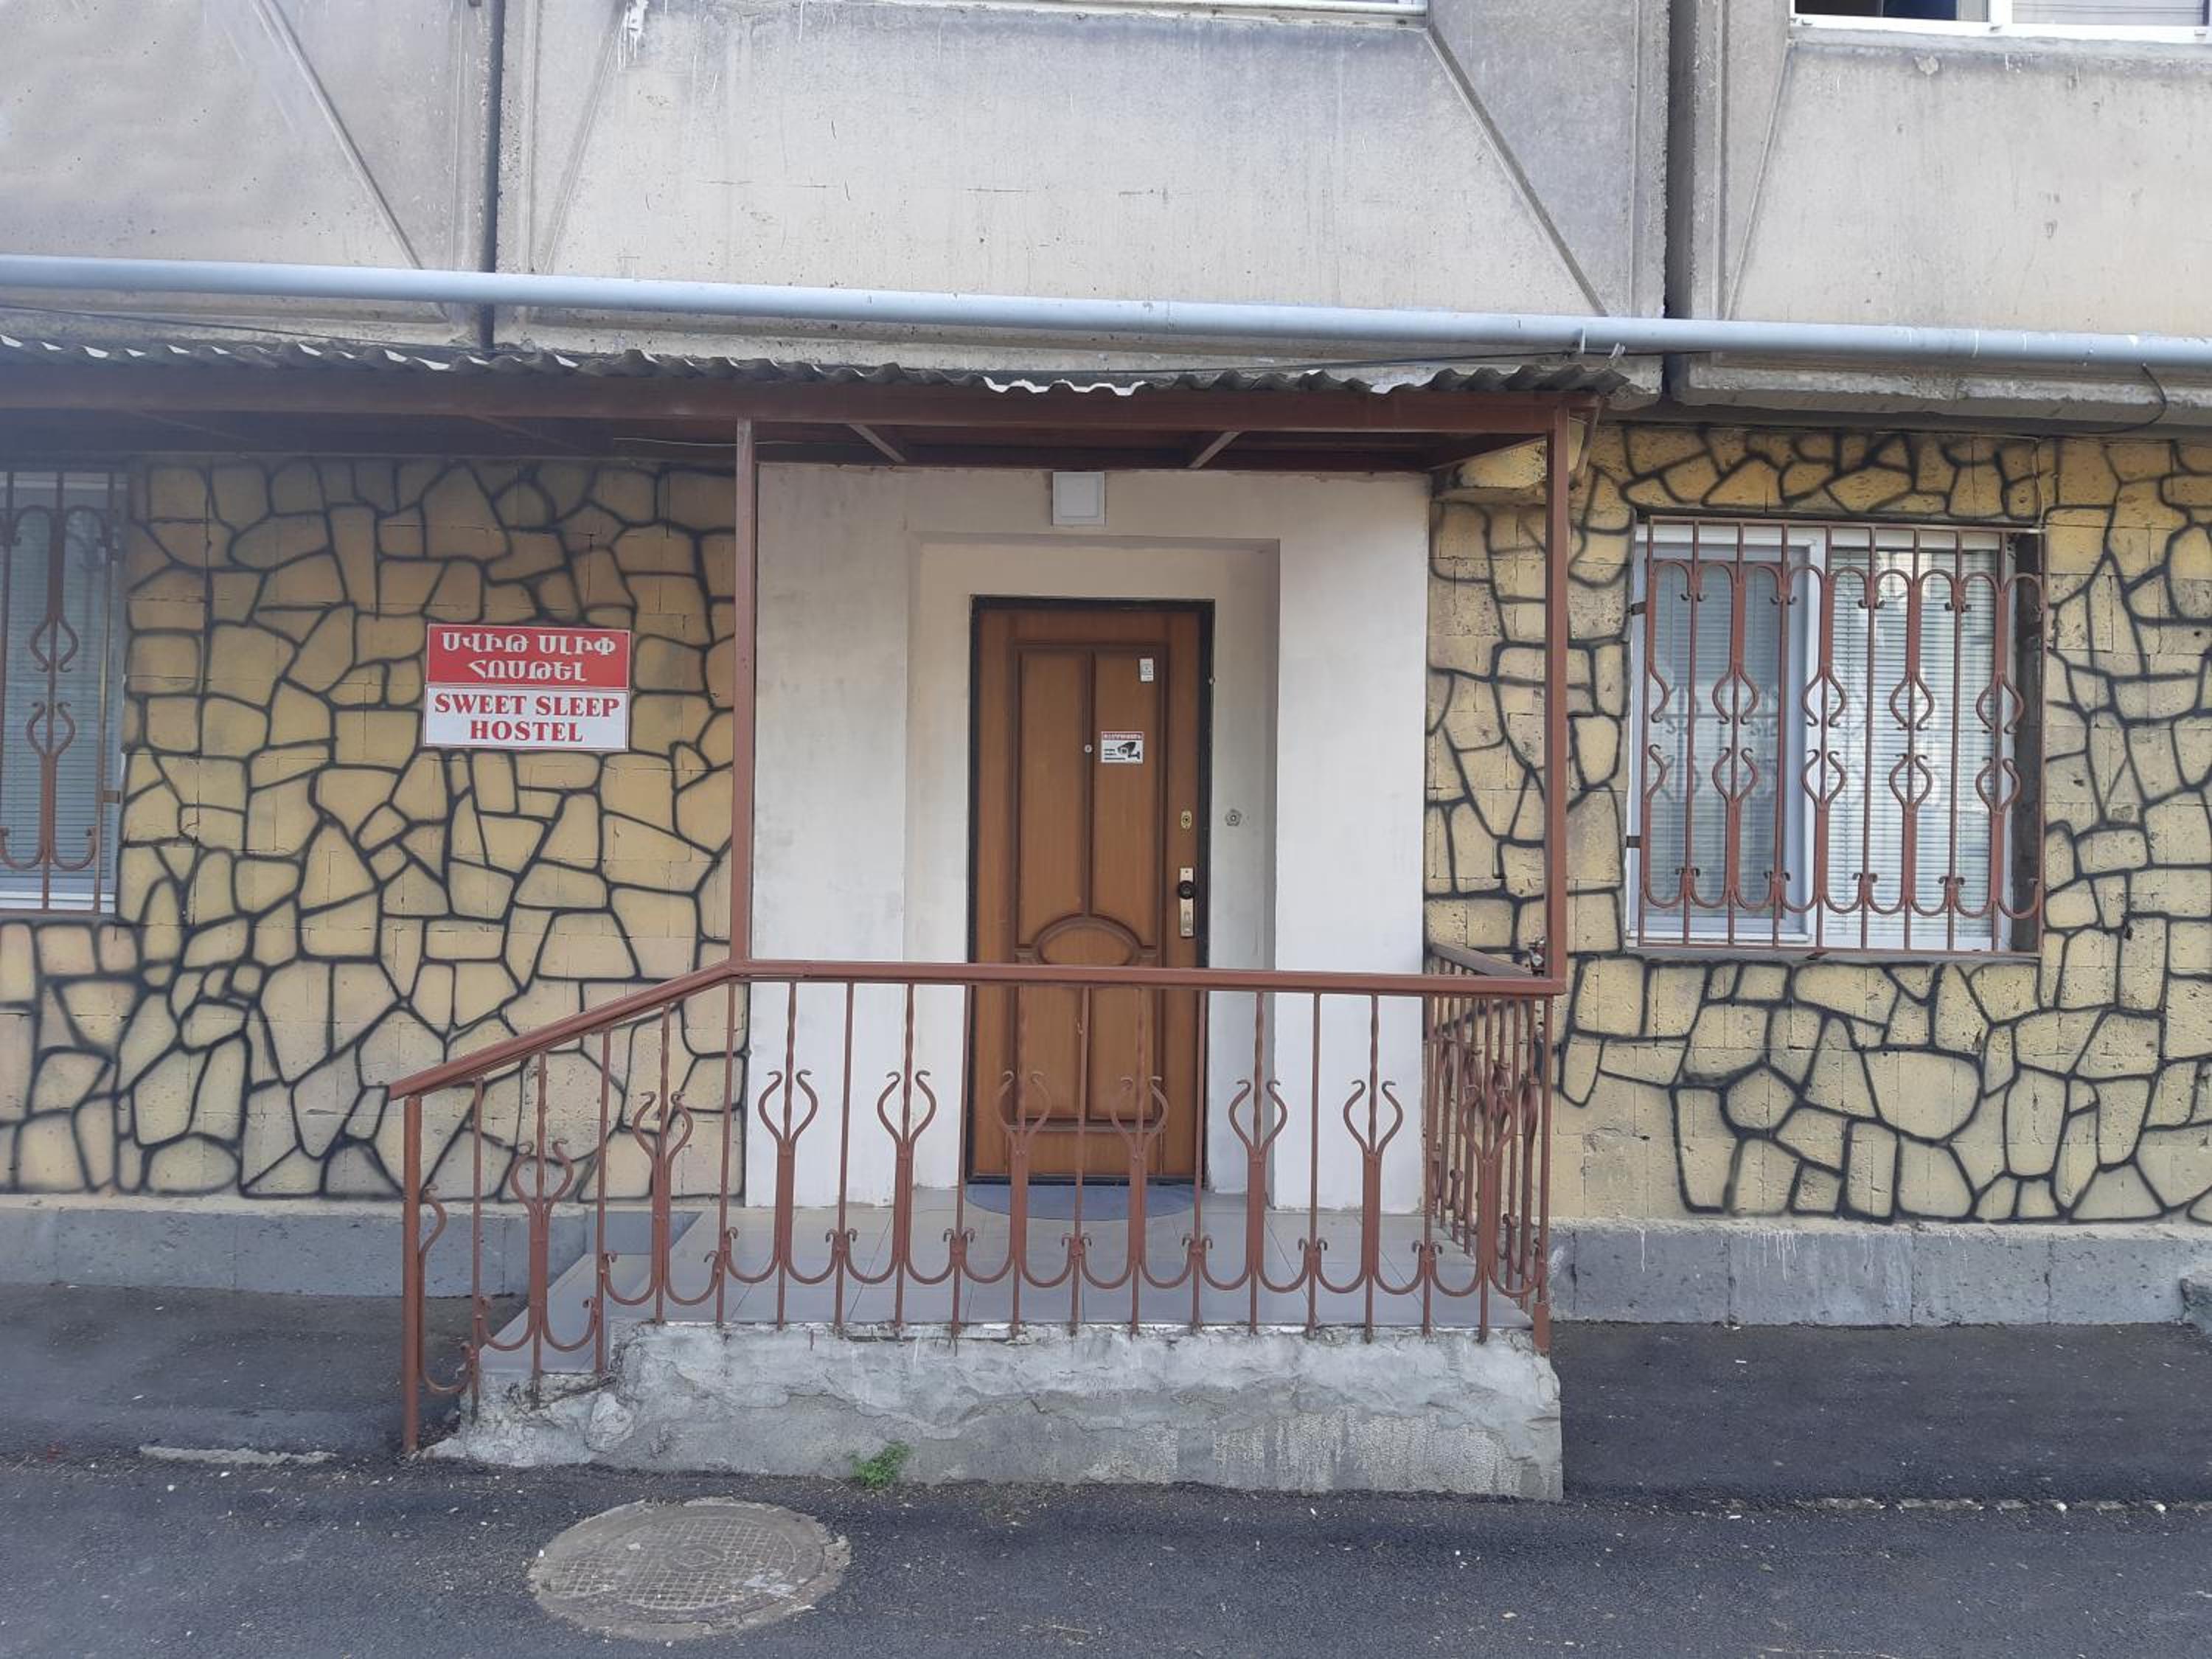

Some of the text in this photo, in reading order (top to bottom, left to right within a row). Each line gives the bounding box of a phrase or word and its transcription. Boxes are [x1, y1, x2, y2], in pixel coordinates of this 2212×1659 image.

[441, 632, 616, 656] ՍՎԻԹ ՍԼԻՓ
[467, 659, 587, 682] ՀՈՍԹԵԼ
[434, 692, 620, 717] SWEET SLEEP
[470, 720, 583, 742] HOSTEL
